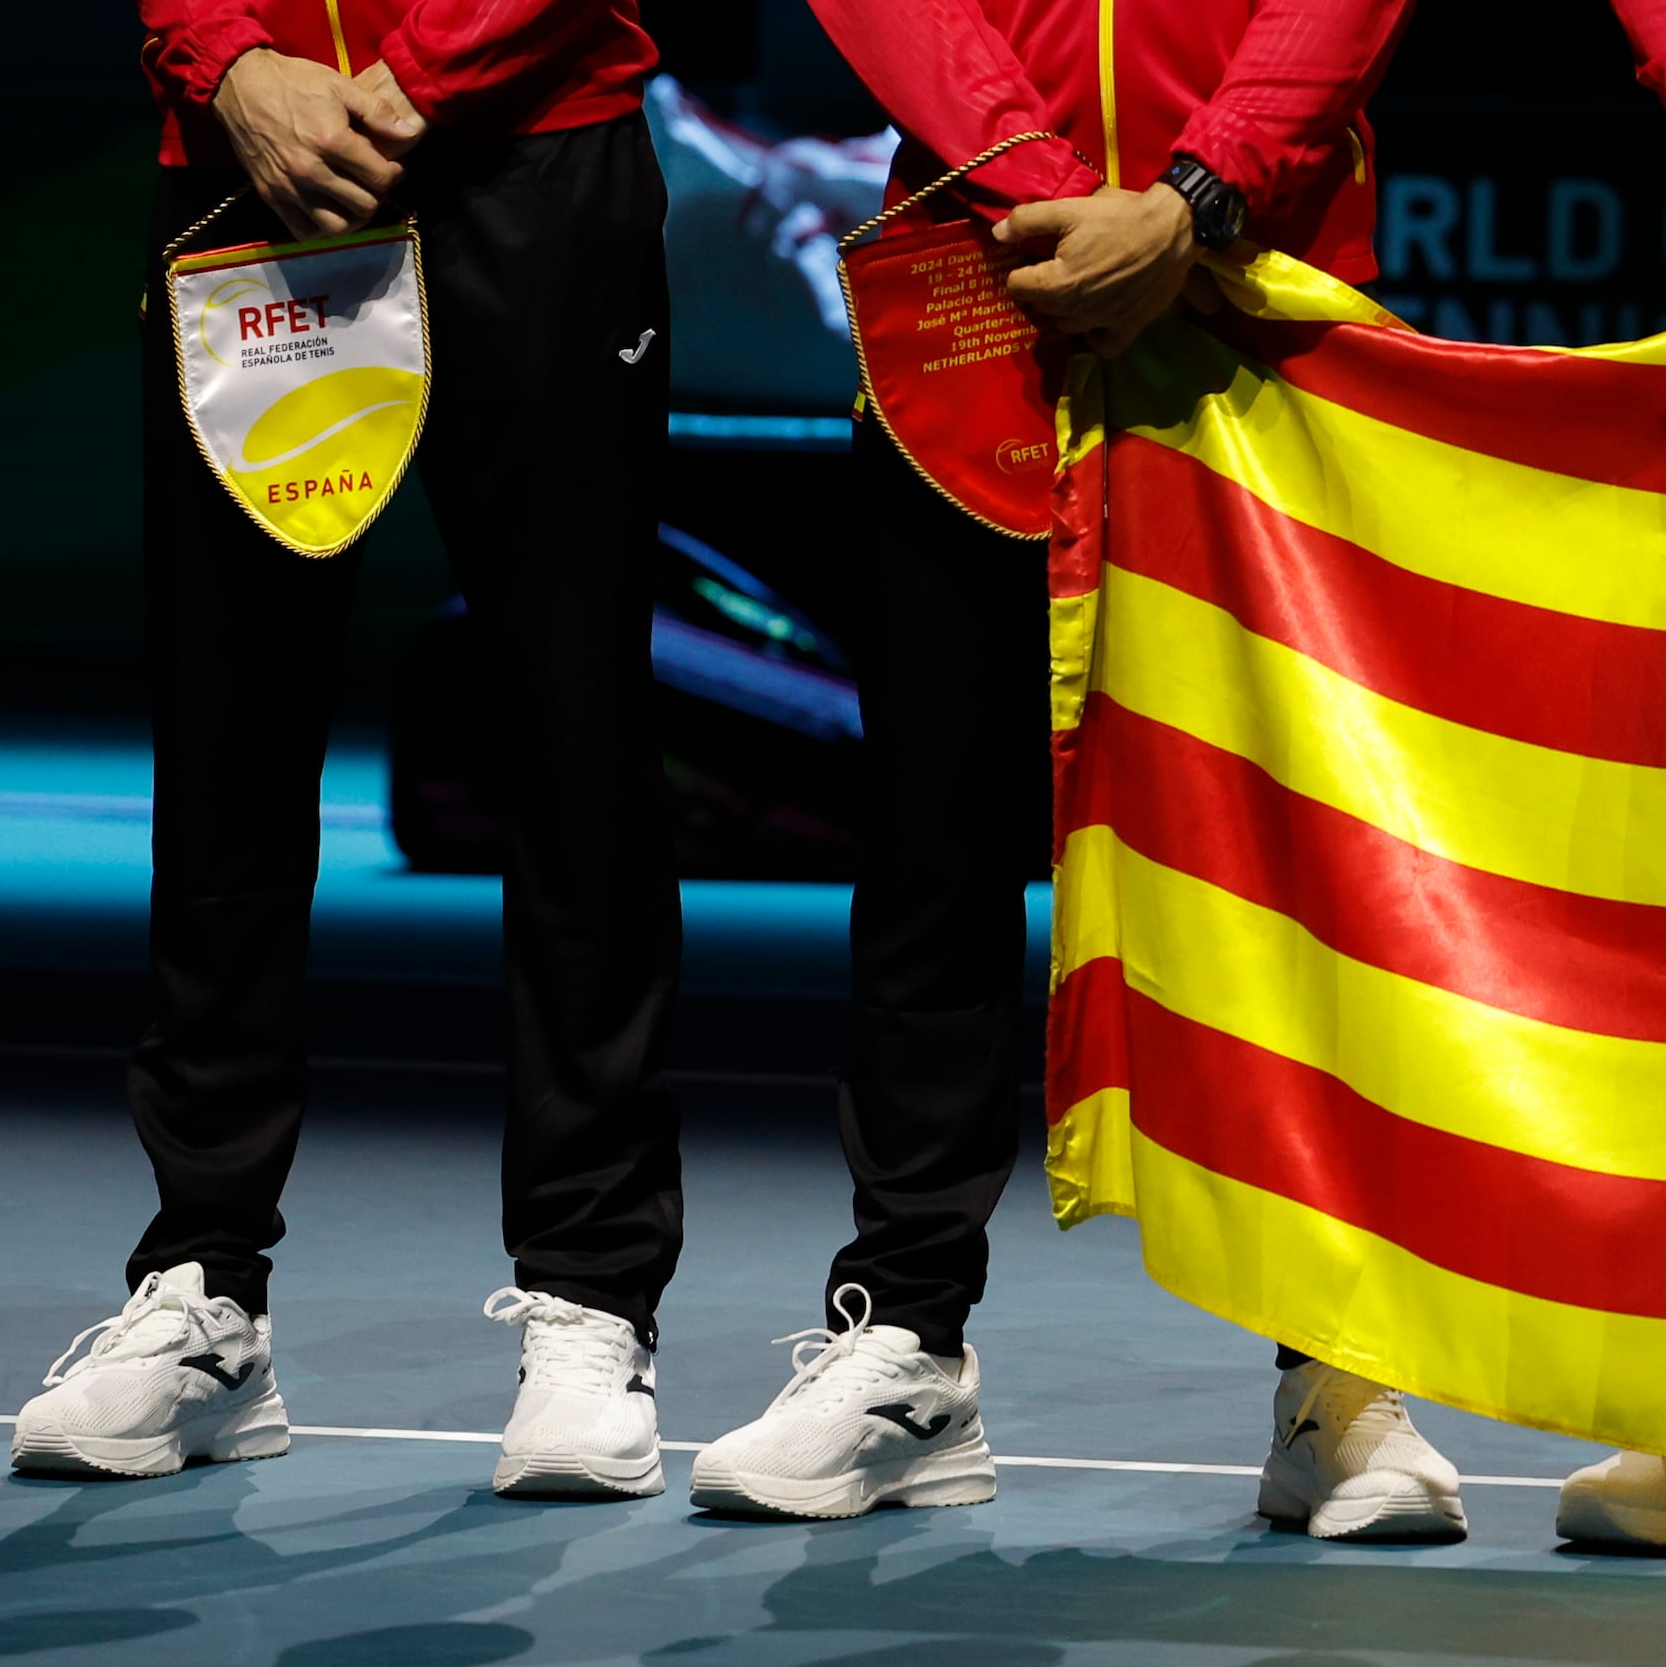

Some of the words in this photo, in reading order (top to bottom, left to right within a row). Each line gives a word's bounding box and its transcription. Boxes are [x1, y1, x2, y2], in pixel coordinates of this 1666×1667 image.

[1381, 172, 1627, 286] RLD
[910, 258, 943, 276] 2024
[957, 265, 974, 278] 24
[933, 281, 964, 297] Final
[926, 294, 974, 314] Palacio
[977, 290, 994, 302] de
[238, 295, 329, 341] RFET
[917, 315, 946, 332] José
[241, 346, 266, 358] REAL
[269, 335, 328, 354] FEDERACIÓN
[951, 337, 980, 352] 19th
[985, 324, 1038, 344] Novemb
[242, 354, 293, 368] ESPAÑOLA
[295, 351, 308, 361] DE
[309, 347, 335, 359] TENIS
[923, 342, 1021, 374] NETHERLANDS
[1010, 442, 1048, 464] RFET
[267, 469, 373, 504] ESPAÑA
